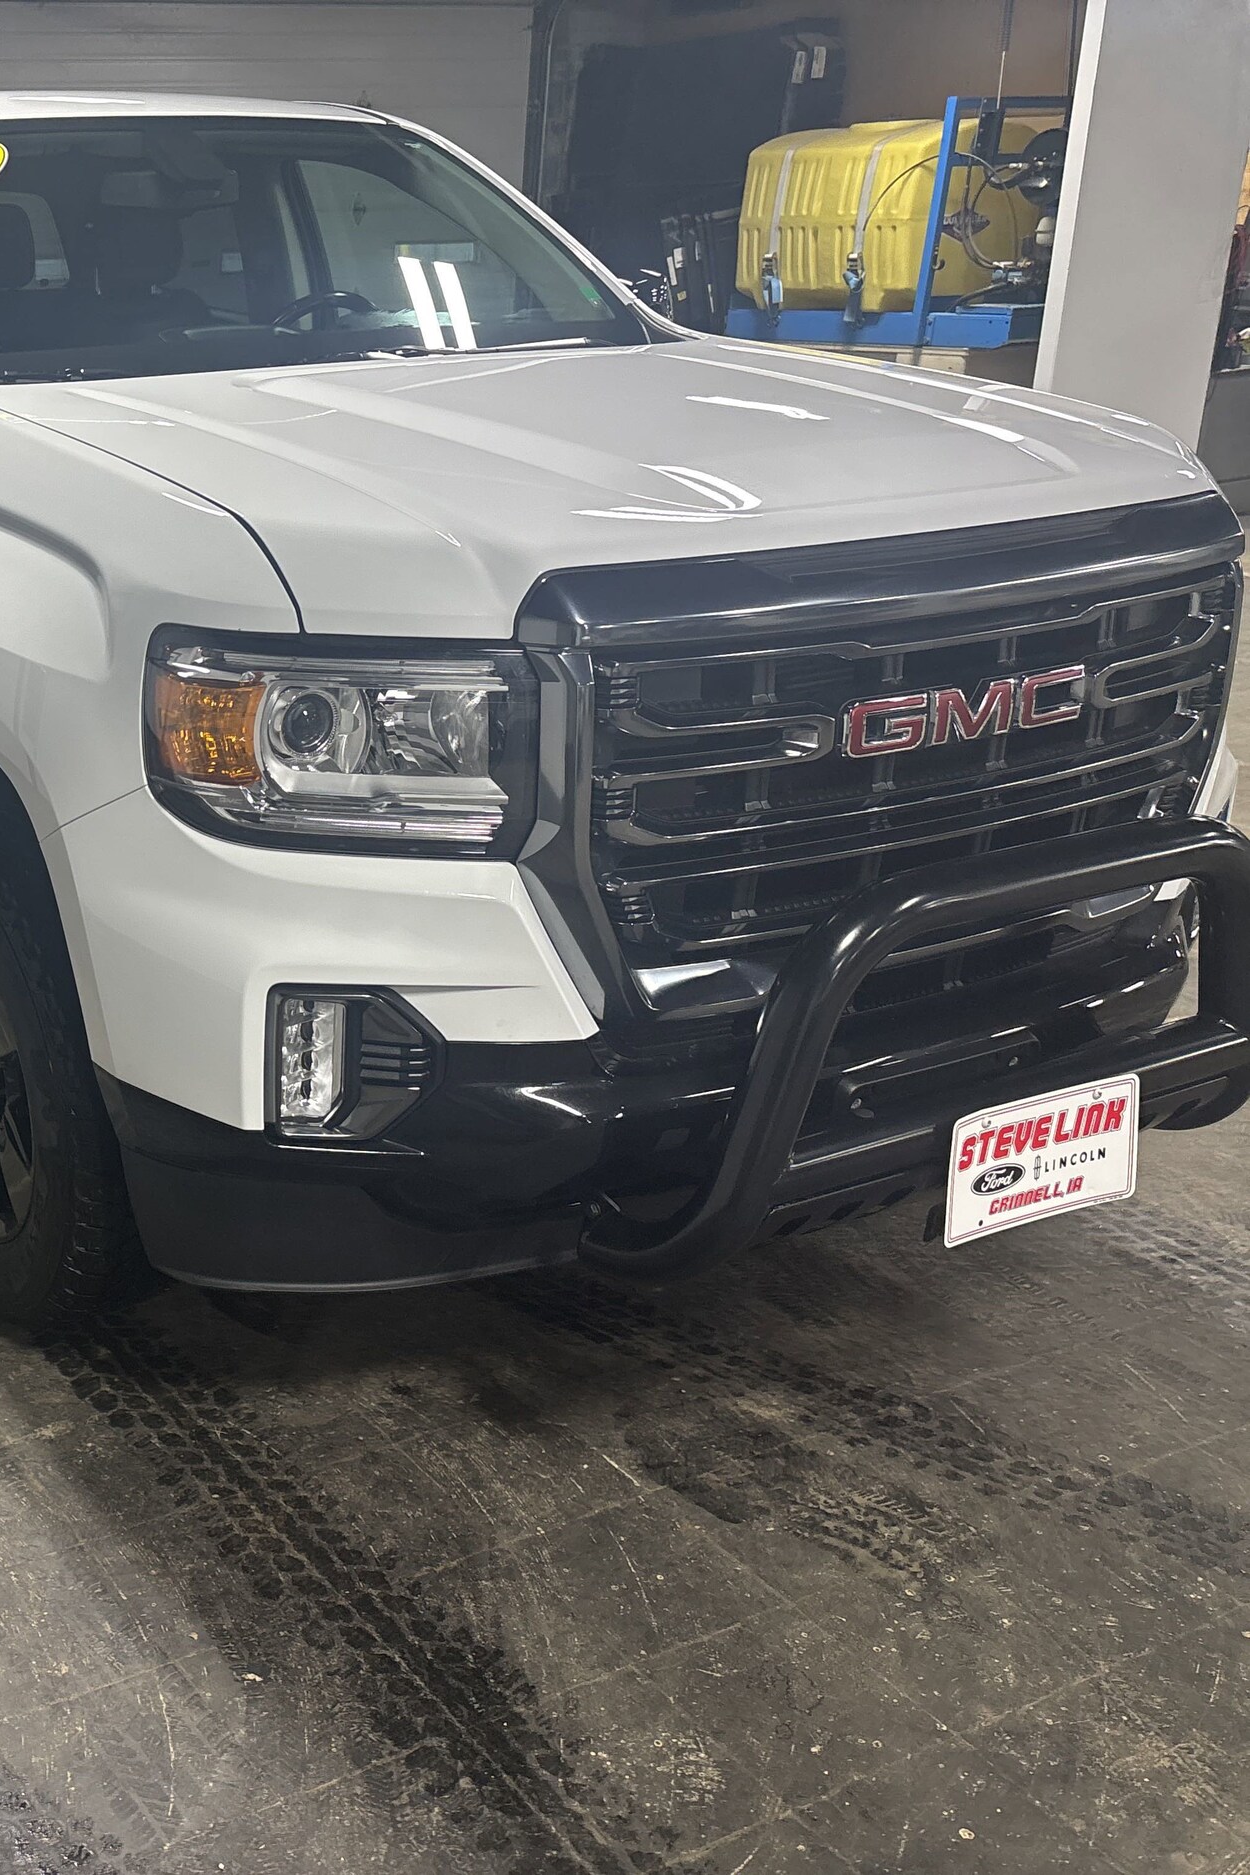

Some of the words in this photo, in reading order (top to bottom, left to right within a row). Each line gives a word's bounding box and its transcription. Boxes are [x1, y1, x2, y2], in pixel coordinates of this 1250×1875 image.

[847, 664, 1085, 759] GMC
[957, 1112, 1055, 1172] STEVE
[1053, 1096, 1129, 1145] LINK
[980, 1168, 1014, 1192] Ford
[1044, 1147, 1107, 1173] LINCOLN
[988, 1181, 1065, 1216] GRINNELL,
[1066, 1175, 1085, 1194] IA
